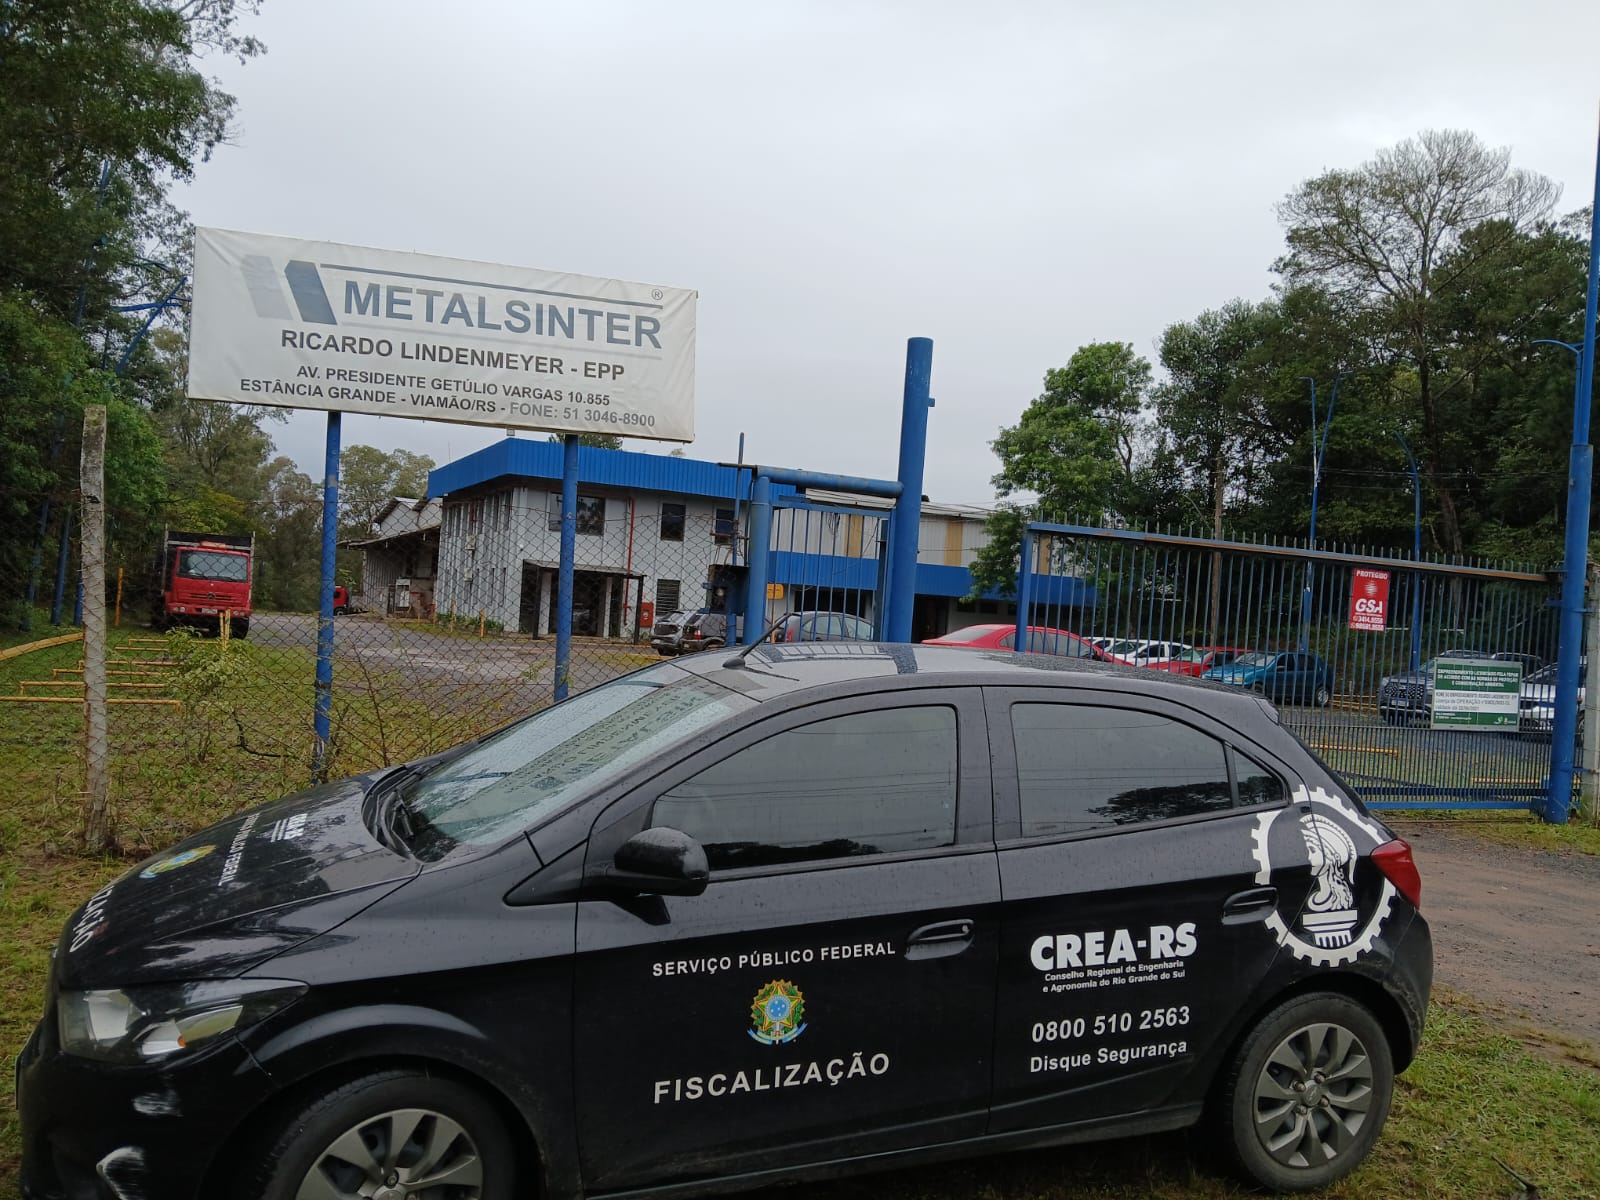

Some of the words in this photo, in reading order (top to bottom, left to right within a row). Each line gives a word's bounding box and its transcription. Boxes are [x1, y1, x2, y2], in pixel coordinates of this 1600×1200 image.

[344, 280, 663, 349] METALSINTER
[281, 329, 393, 357] RICARDO
[401, 342, 564, 375] LINDENMEYER
[584, 361, 625, 381] EPP
[240, 377, 323, 398] ESTÂNCIA
[328, 386, 397, 404] GRANDE
[410, 390, 496, 413] VIAMÃO/RS
[510, 401, 559, 420] FONE:
[563, 406, 580, 421] 51
[584, 407, 656, 427] 3046-8900
[297, 365, 319, 379] AV.
[326, 367, 426, 388] PRESIDENTE
[431, 373, 498, 396] GETÚLIO
[502, 384, 562, 402] VARGAS
[568, 391, 610, 406] 10.855
[1355, 598, 1383, 614] GSA
[652, 956, 732, 977] SERVIÇO
[739, 949, 814, 969] PÚBLICO
[821, 941, 896, 961] FEDERAL
[1030, 922, 1198, 971] CREA-RS
[1042, 985, 1049, 993] e
[1051, 979, 1097, 993] Agronomia
[1099, 977, 1110, 987] do
[1112, 976, 1126, 986] Rio
[1128, 972, 1158, 984] Grande
[1160, 971, 1171, 980] do
[1172, 969, 1186, 979] Sul
[1045, 970, 1084, 982] Conselho
[1086, 966, 1123, 978] Regional
[1125, 964, 1136, 973] de
[1138, 960, 1184, 973] Engenharia
[1032, 1017, 1086, 1043] 0800
[1093, 1012, 1132, 1035] 510
[1139, 1005, 1190, 1030] 2563
[1030, 1052, 1092, 1073] Disque
[1097, 1041, 1187, 1065] Segurança
[654, 1051, 890, 1105] FISCALIZAÇÃO
